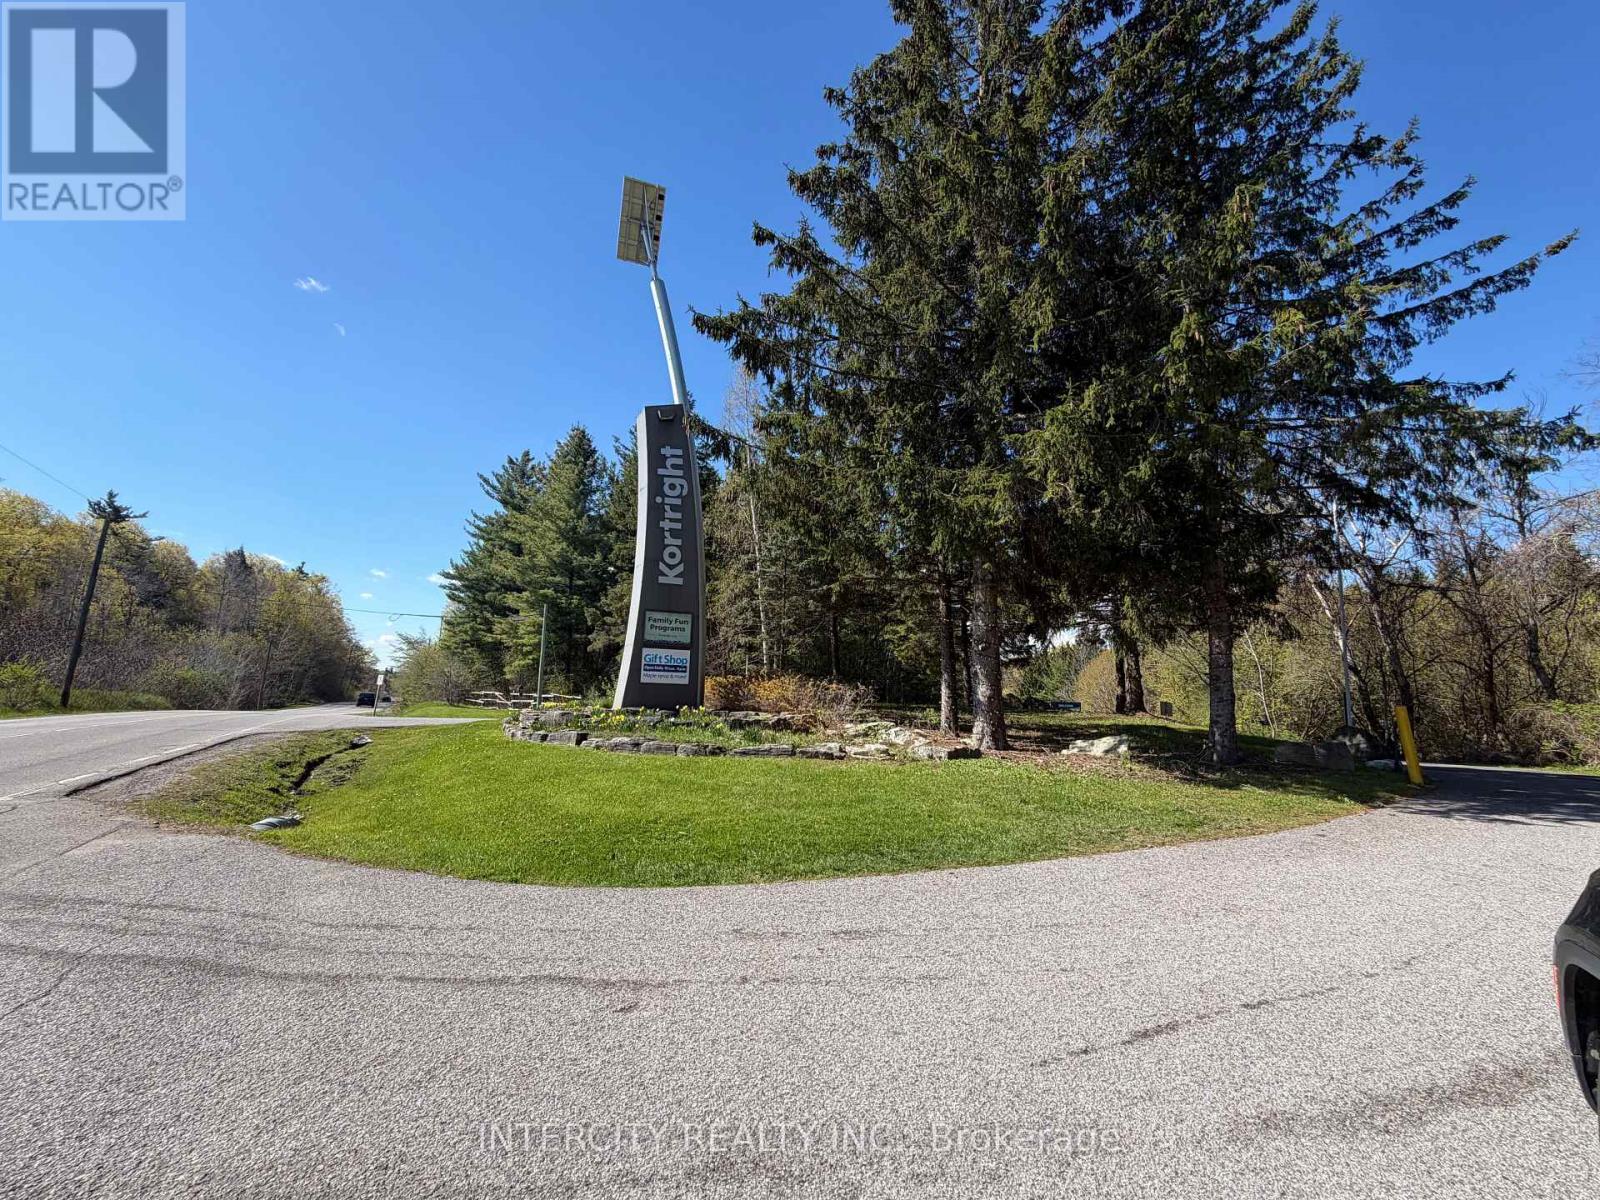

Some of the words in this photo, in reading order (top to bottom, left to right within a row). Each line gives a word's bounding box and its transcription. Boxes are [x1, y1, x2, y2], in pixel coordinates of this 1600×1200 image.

[655, 446, 688, 585] Kortright
[648, 617, 673, 625] Family
[650, 624, 686, 633] Programs
[644, 653, 662, 663] Gift
[664, 654, 688, 665] Shop
